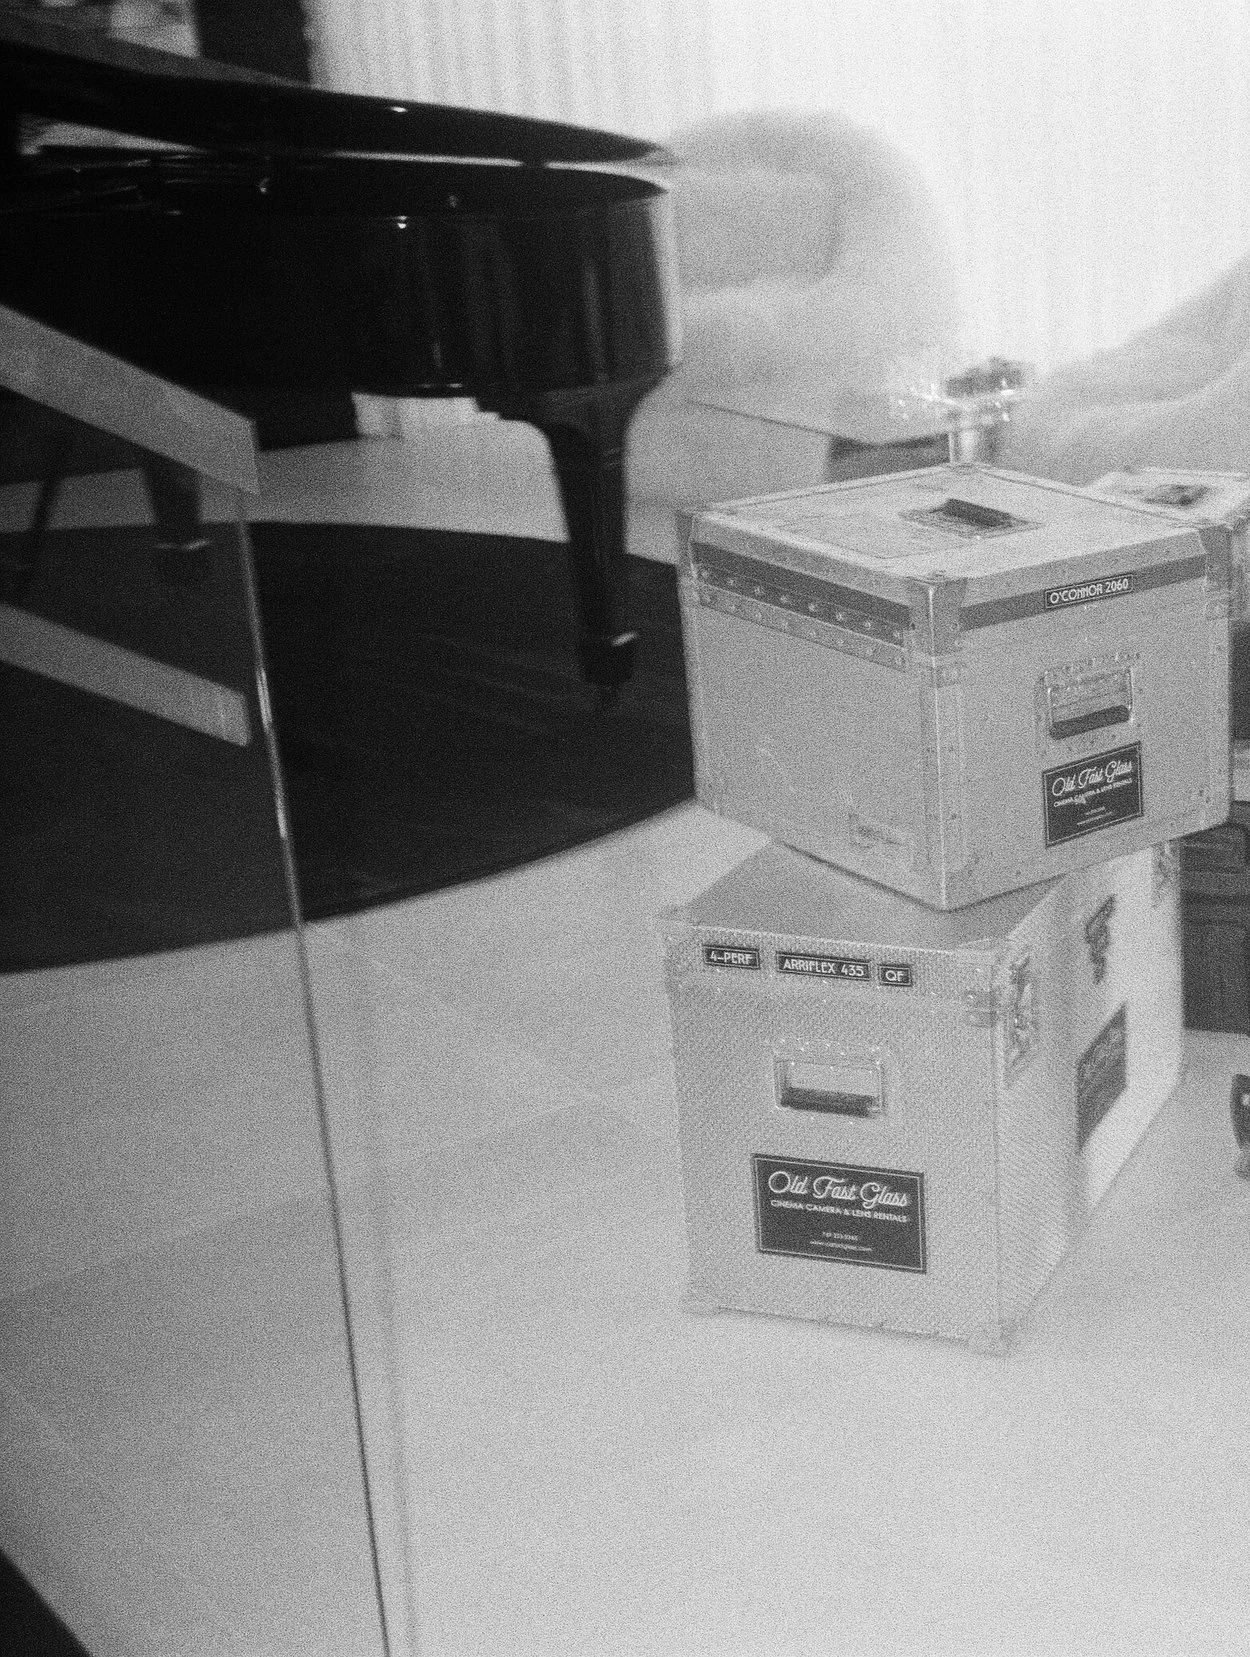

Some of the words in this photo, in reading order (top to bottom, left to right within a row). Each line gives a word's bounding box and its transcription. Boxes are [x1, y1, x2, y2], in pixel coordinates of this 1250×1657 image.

[1050, 583, 1103, 604] O'CONNOR
[1105, 578, 1129, 593] 2060
[1052, 774, 1076, 796] Old
[1078, 766, 1104, 788] Fast
[1105, 760, 1133, 783] Glass
[710, 950, 752, 965] 4-PERF
[783, 958, 836, 974] ARRIFLEX
[841, 963, 865, 977] 435
[885, 969, 904, 982] QF
[768, 1171, 808, 1194] Old
[813, 1176, 857, 1198] Fast
[860, 1182, 908, 1209] Glass
[770, 1199, 804, 1210] CINEMA
[805, 1203, 842, 1214] CAMERA
[873, 1211, 908, 1223] RENTALS
